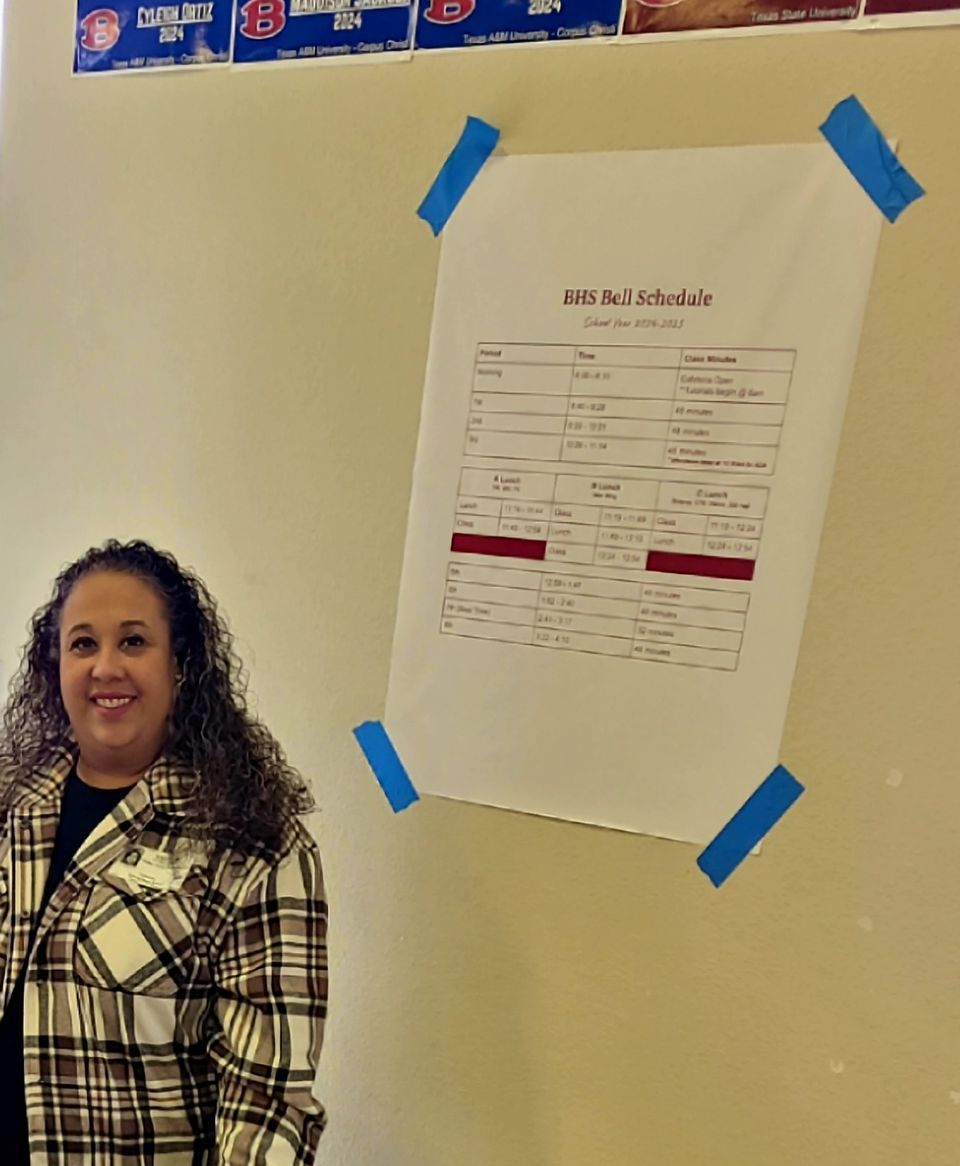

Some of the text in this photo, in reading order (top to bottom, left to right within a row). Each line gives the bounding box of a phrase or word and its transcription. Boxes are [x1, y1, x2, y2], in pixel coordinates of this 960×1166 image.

[333, 12, 362, 31] 2024
[751, 5, 857, 23] Texas State University
[563, 288, 714, 307] BHS Bell Schedule
